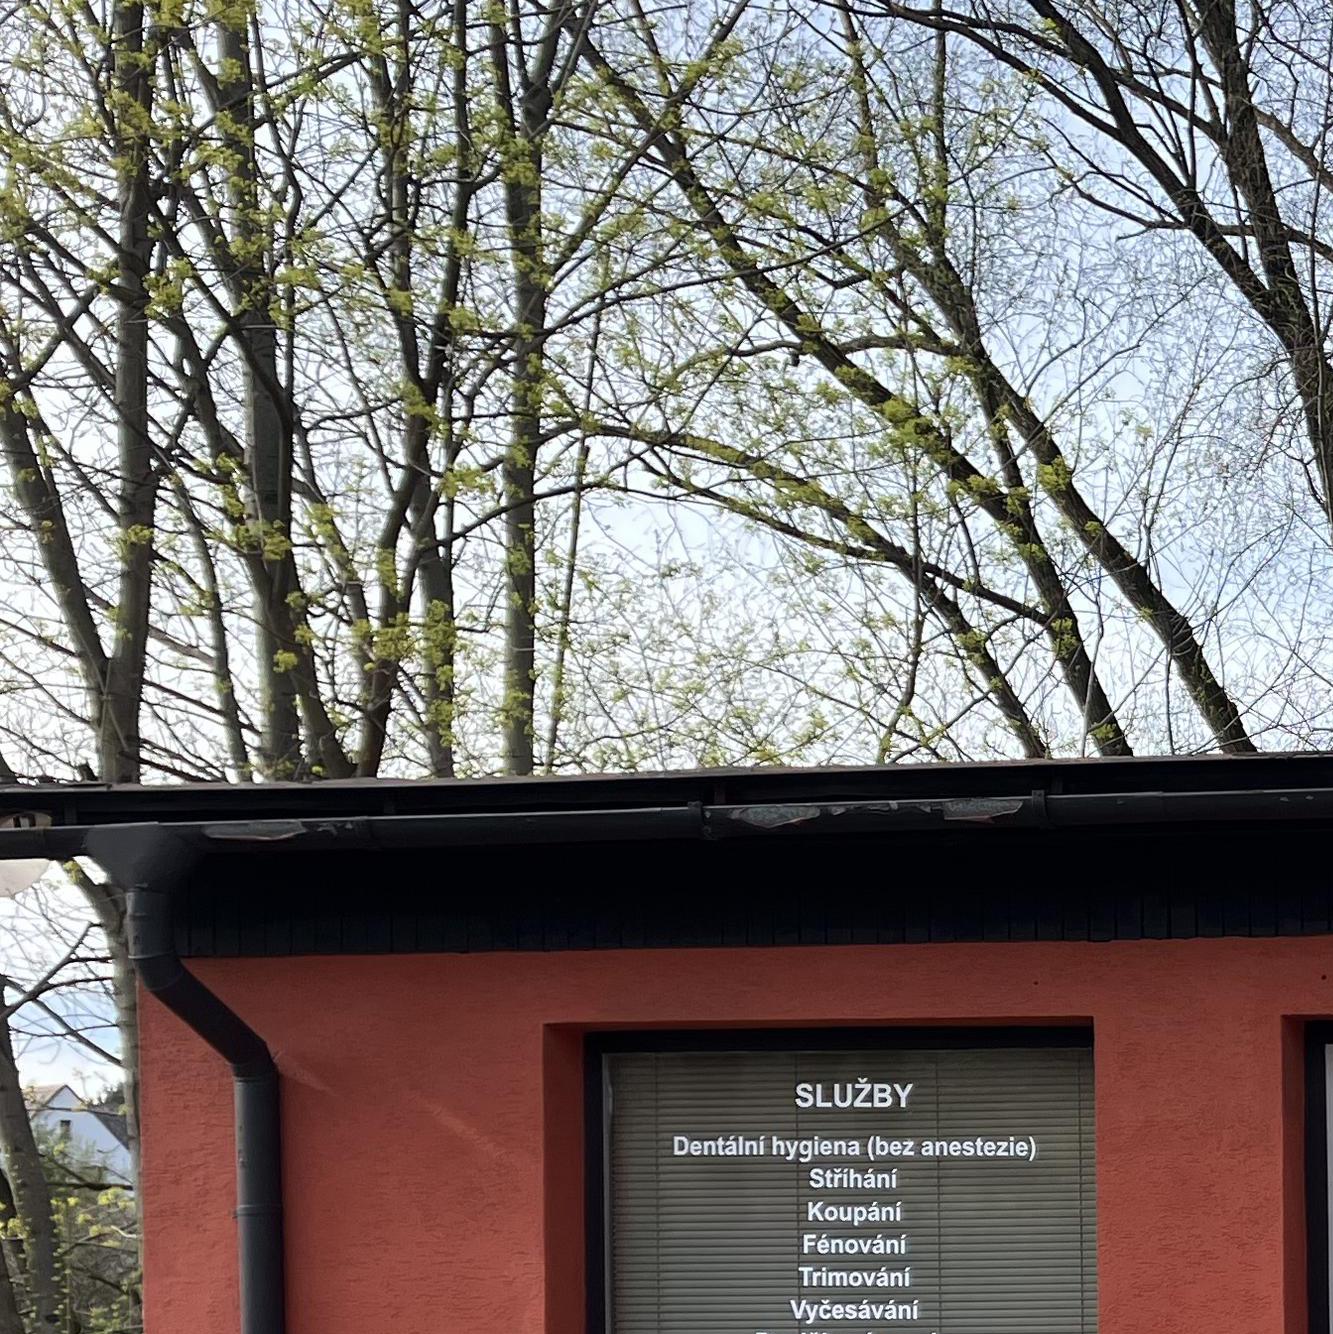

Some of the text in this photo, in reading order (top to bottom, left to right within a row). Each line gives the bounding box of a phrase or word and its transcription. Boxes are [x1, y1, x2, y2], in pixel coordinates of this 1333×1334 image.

[795, 1078, 913, 1108] SLUŽBY
[673, 1135, 1037, 1162] Dentální hygiena (bez anestezie)
[809, 1167, 897, 1189] Stříhání
[808, 1200, 901, 1225] Koupání
[803, 1233, 907, 1255] Fénování
[799, 1266, 910, 1288] Trimování
[790, 1298, 918, 1324] Vyčesávání
